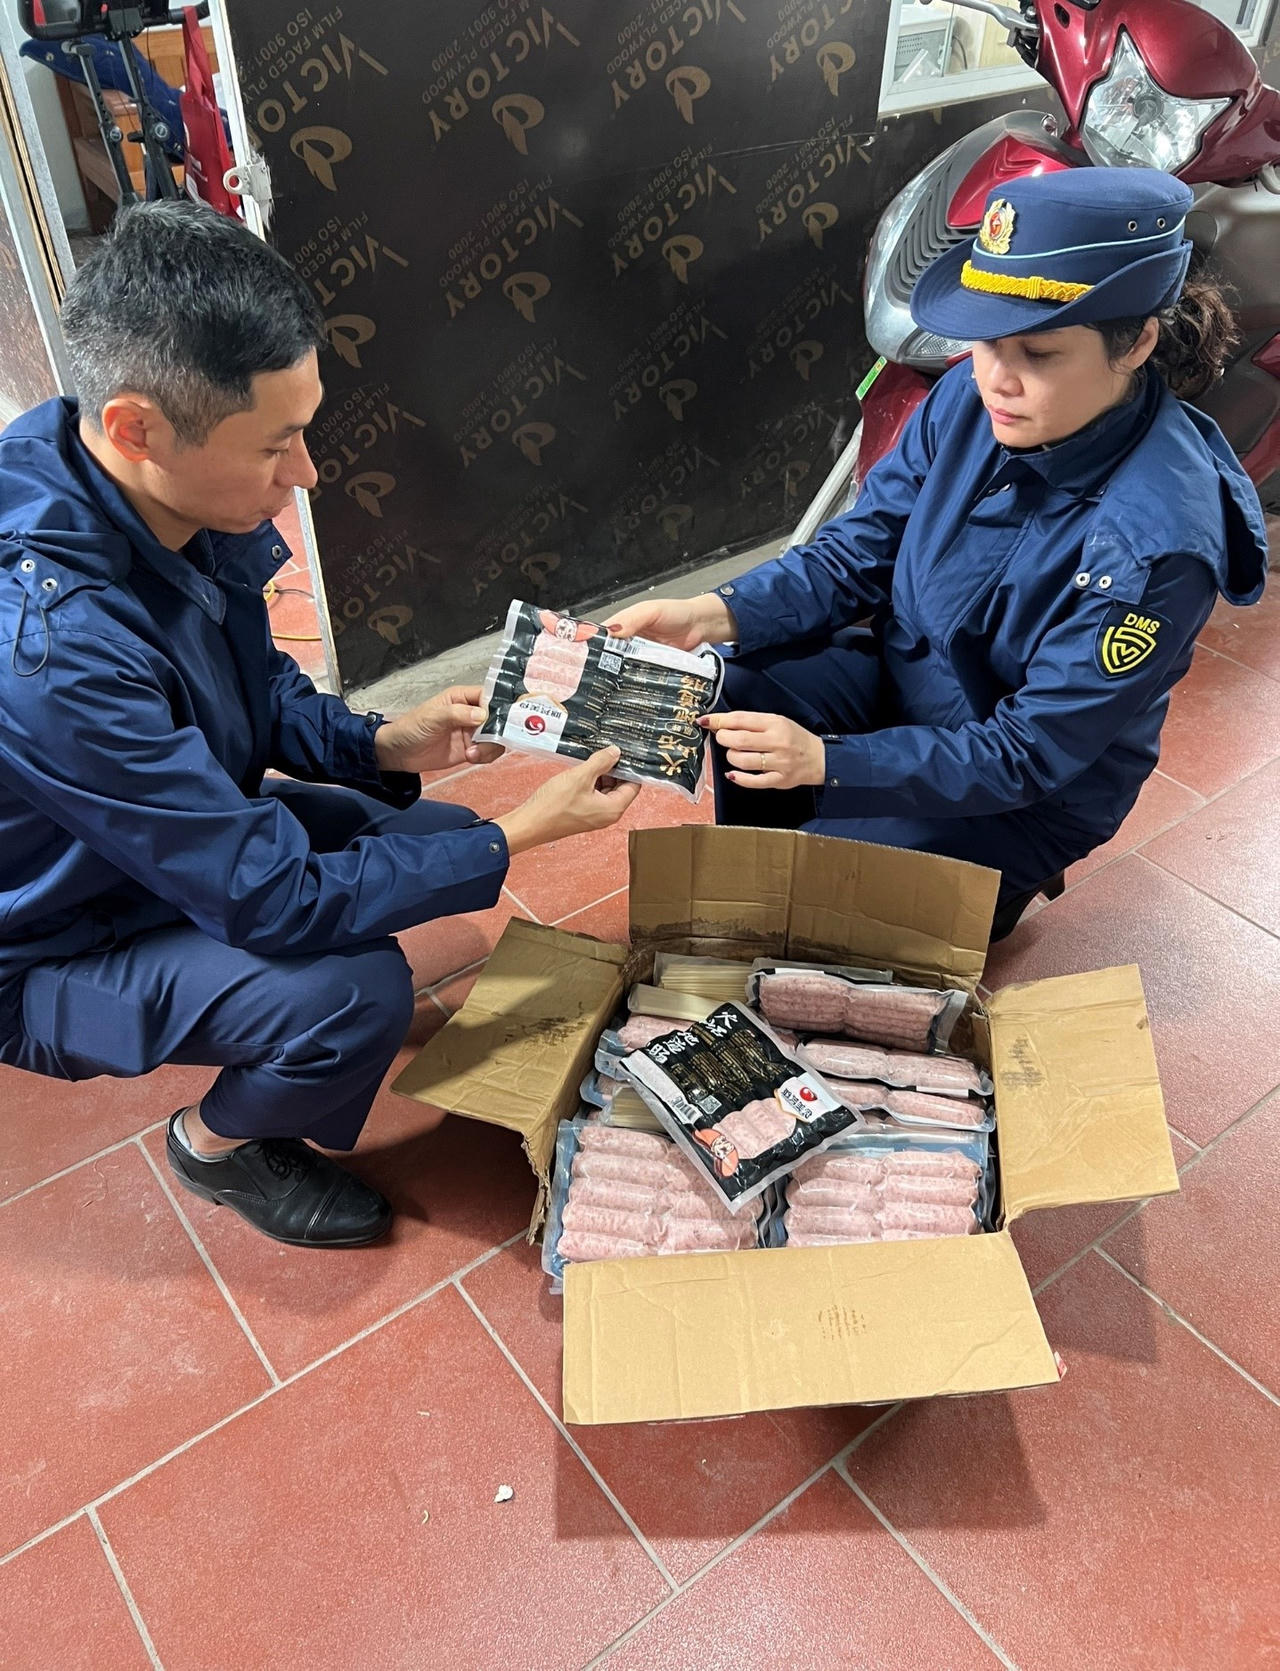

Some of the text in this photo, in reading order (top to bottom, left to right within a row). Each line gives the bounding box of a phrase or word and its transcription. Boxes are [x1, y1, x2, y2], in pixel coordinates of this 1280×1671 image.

[286, 8, 313, 37] ISO
[311, 6, 344, 39] FILM
[269, 36, 312, 79] FACED
[422, 9, 518, 104] FACED PLYWOOD
[427, 8, 582, 143] VICTORY
[431, 39, 461, 72] 2000
[817, 115, 836, 138] ISO
[673, 145, 693, 169] ISO
[508, 178, 530, 202] ISO
[656, 167, 688, 201] FACED
[757, 135, 872, 244] VICTORY
[294, 215, 344, 264] ISO 900
[491, 200, 527, 238] FACED
[611, 163, 737, 278] VICTORY
[300, 210, 369, 279] FILM FACED
[445, 194, 584, 319] VICTORY
[313, 232, 409, 306] VICT
[612, 313, 728, 422] VICTORY
[343, 387, 366, 411] ISO
[460, 355, 587, 470] VICTORY
[328, 408, 364, 445] FACED
[471, 494, 589, 598] VICTORY
[1124, 613, 1160, 634] DMS
